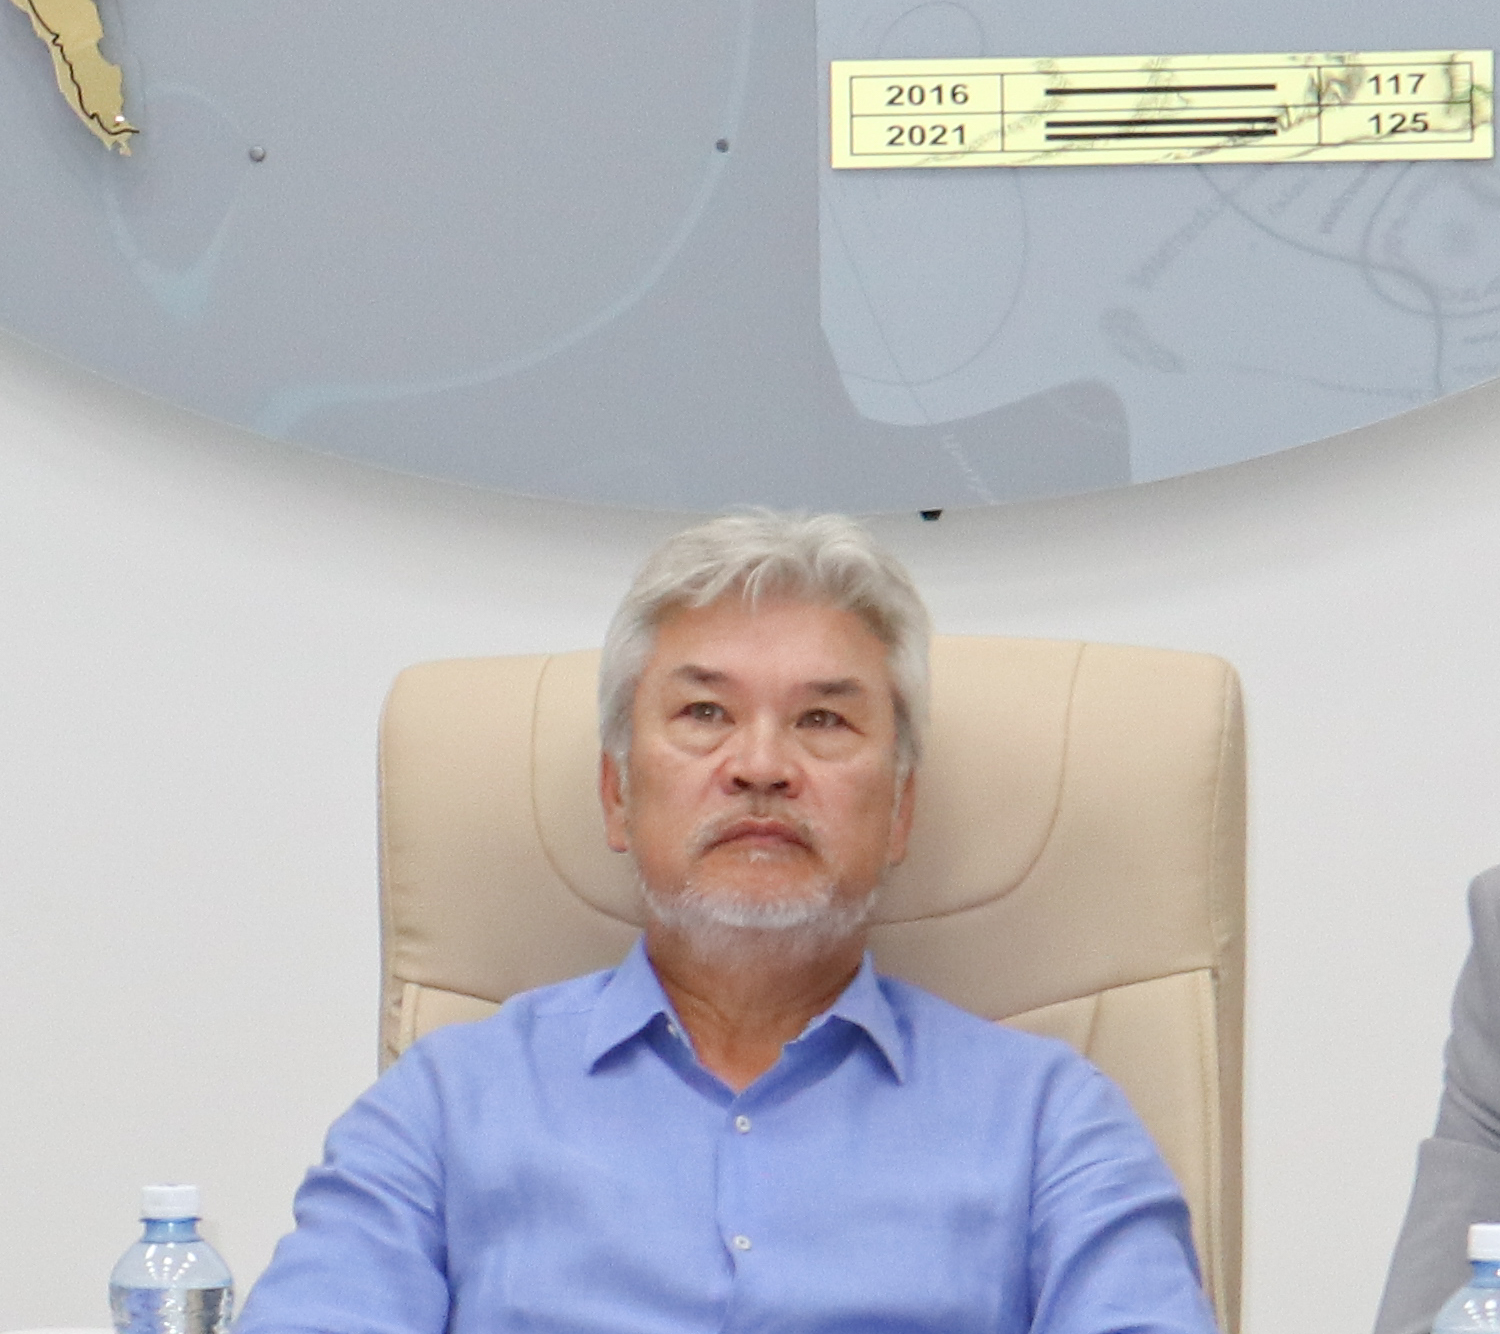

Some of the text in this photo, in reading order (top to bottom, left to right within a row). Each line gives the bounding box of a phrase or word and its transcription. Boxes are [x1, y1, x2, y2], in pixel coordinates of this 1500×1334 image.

[886, 71, 1427, 107] 2016 117
[886, 111, 1430, 147] 2021 125
